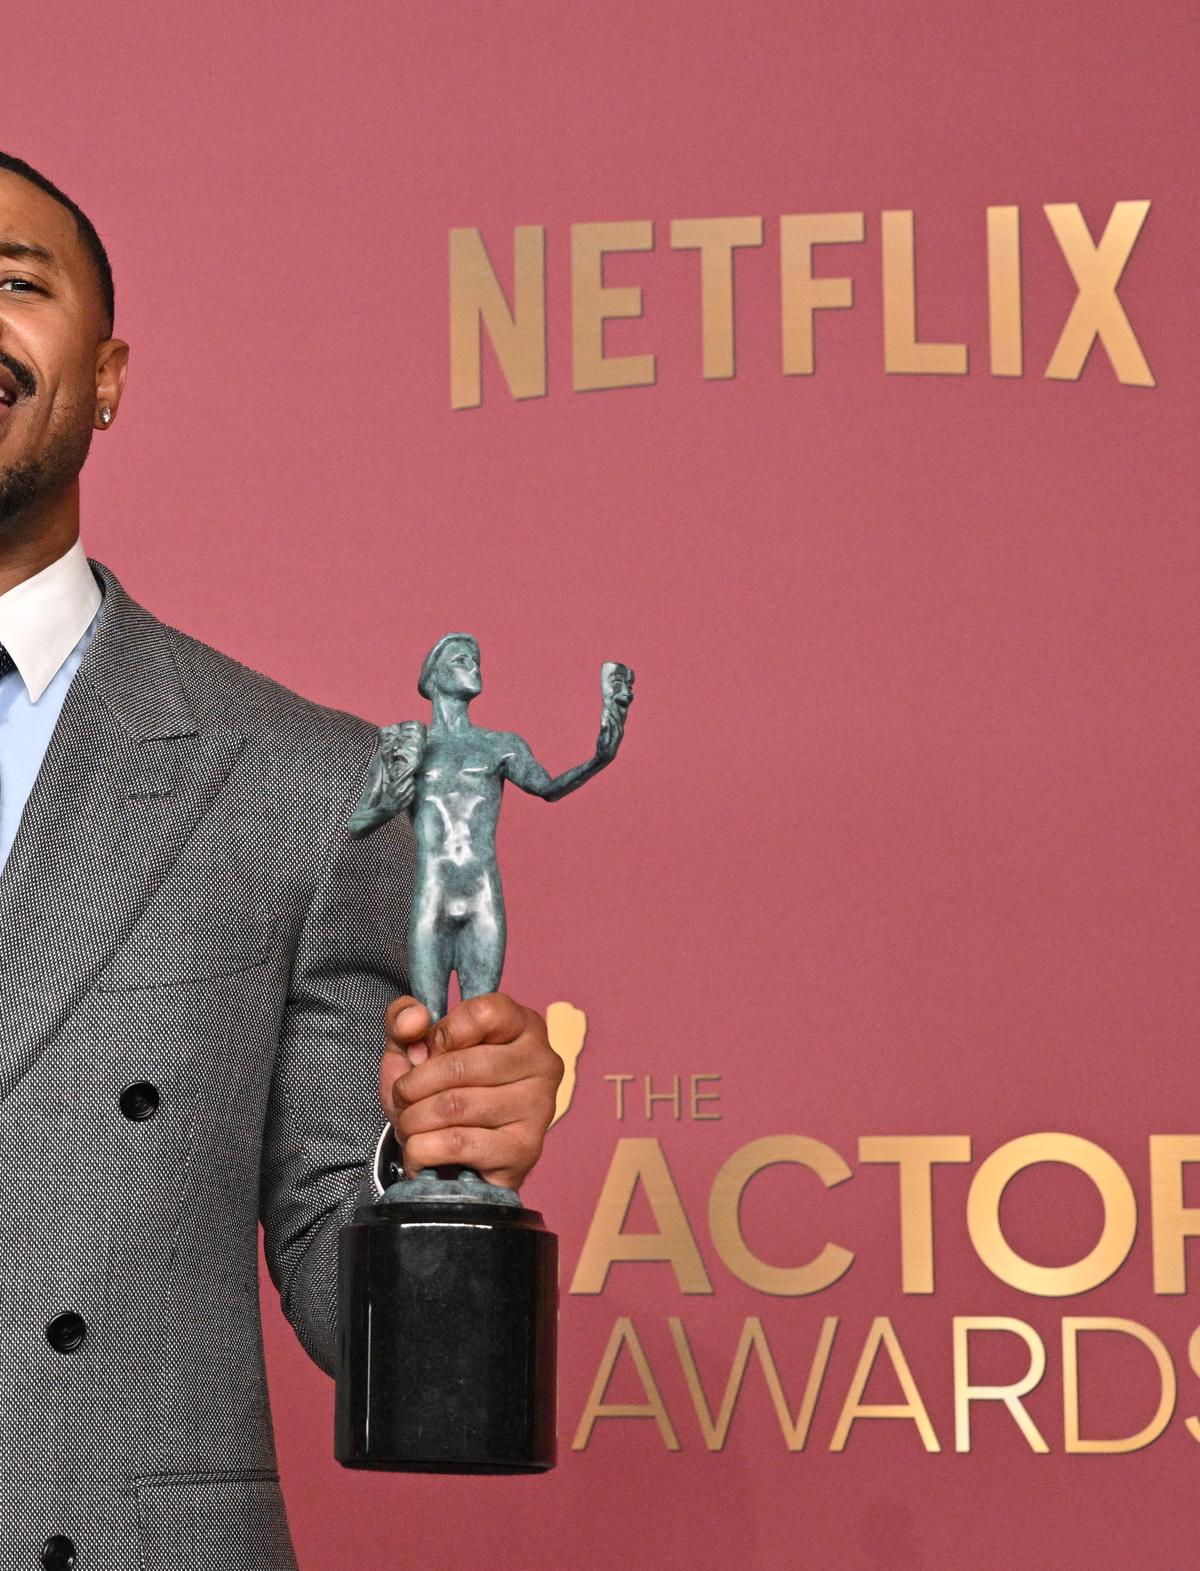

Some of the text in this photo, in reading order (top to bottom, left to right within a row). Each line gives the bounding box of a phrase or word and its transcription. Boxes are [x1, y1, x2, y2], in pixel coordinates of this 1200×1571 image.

[448, 200, 1157, 411] NETFLIX
[605, 1074, 722, 1121] THE
[571, 1316, 1200, 1455] AWARD
